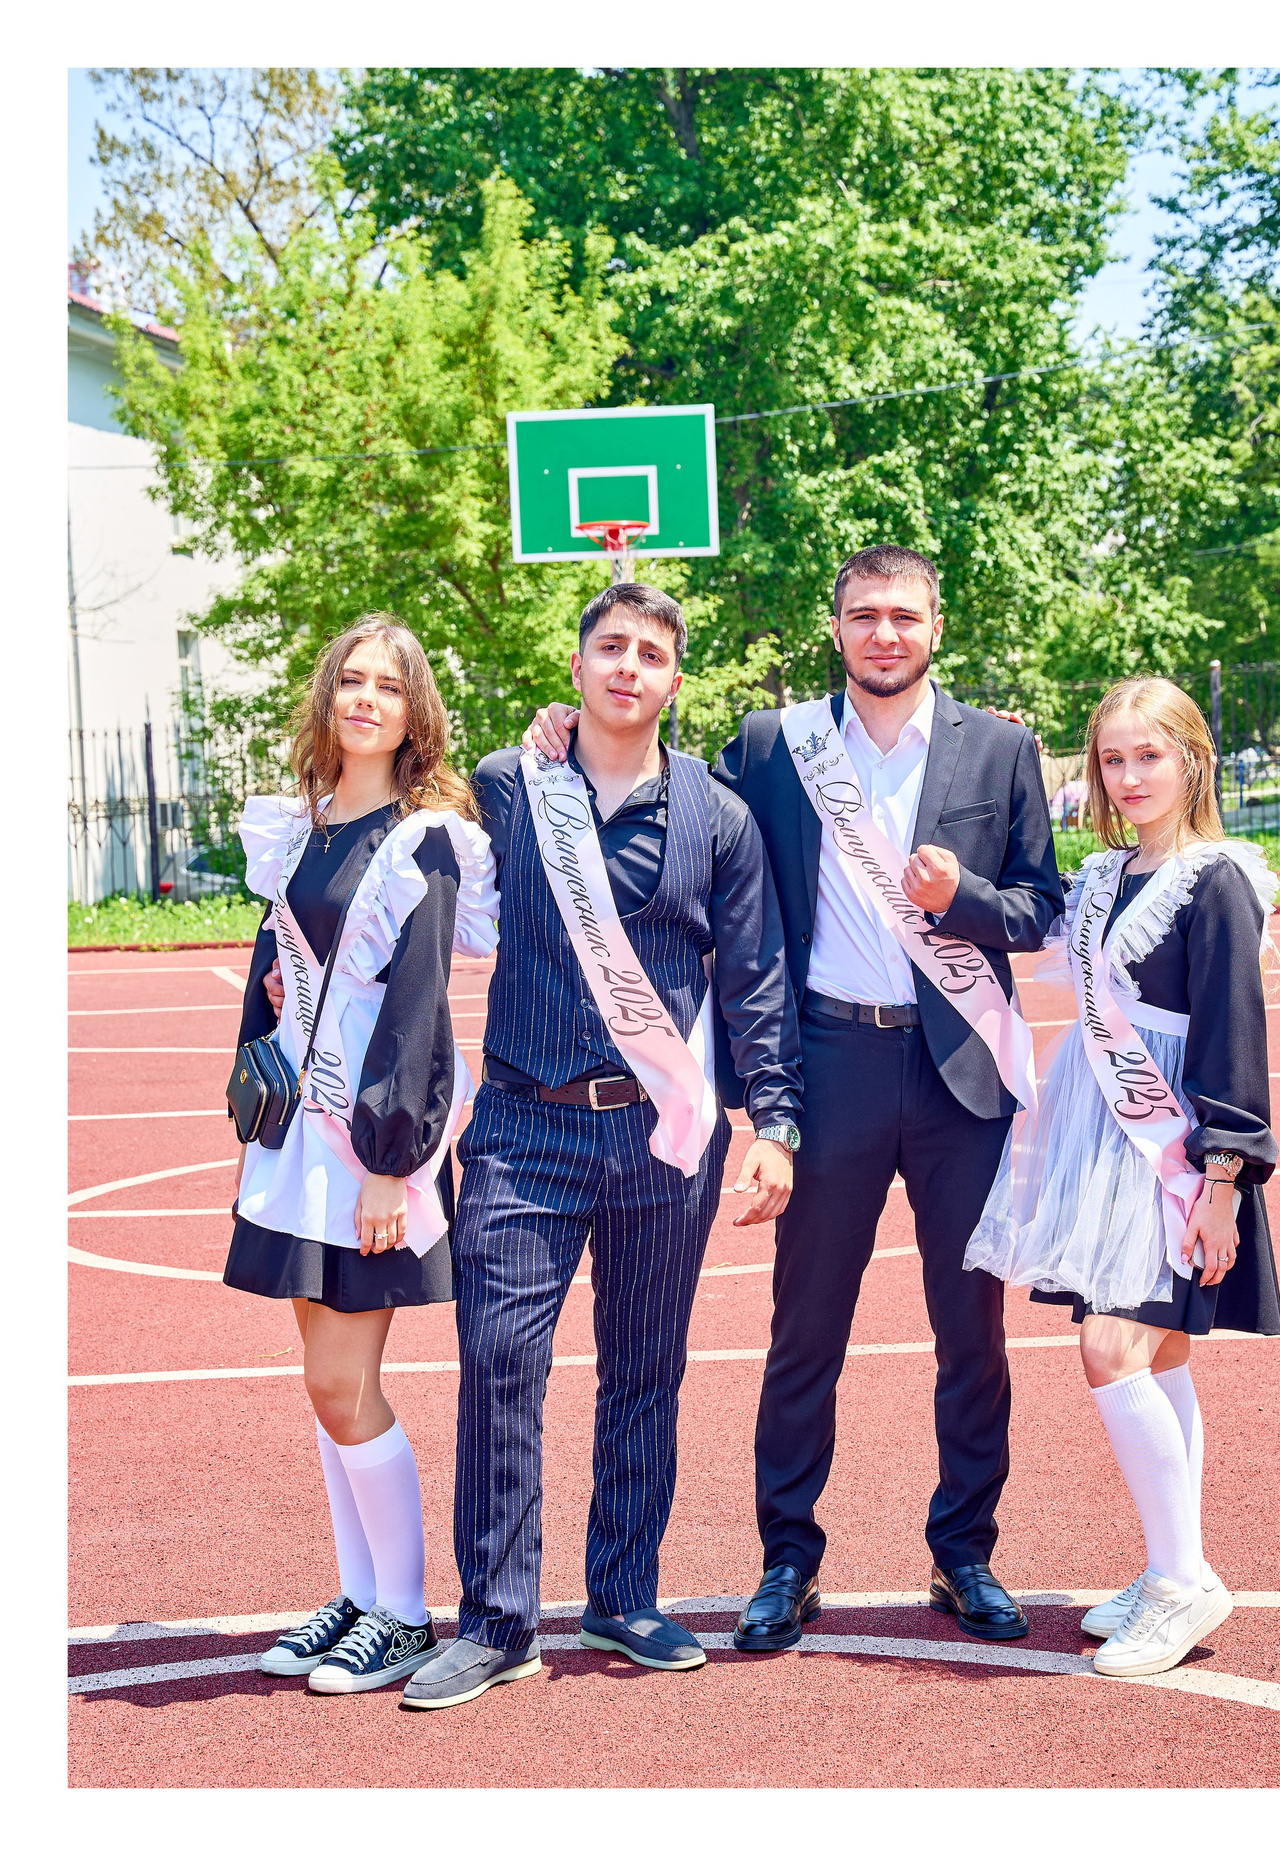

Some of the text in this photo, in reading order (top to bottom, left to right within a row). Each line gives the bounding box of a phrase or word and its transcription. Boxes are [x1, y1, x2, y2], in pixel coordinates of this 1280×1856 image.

[537, 790, 675, 1038] Выпускник 2025
[815, 781, 925, 925] Выпускник
[1070, 891, 1181, 1121] Выпускница 2025
